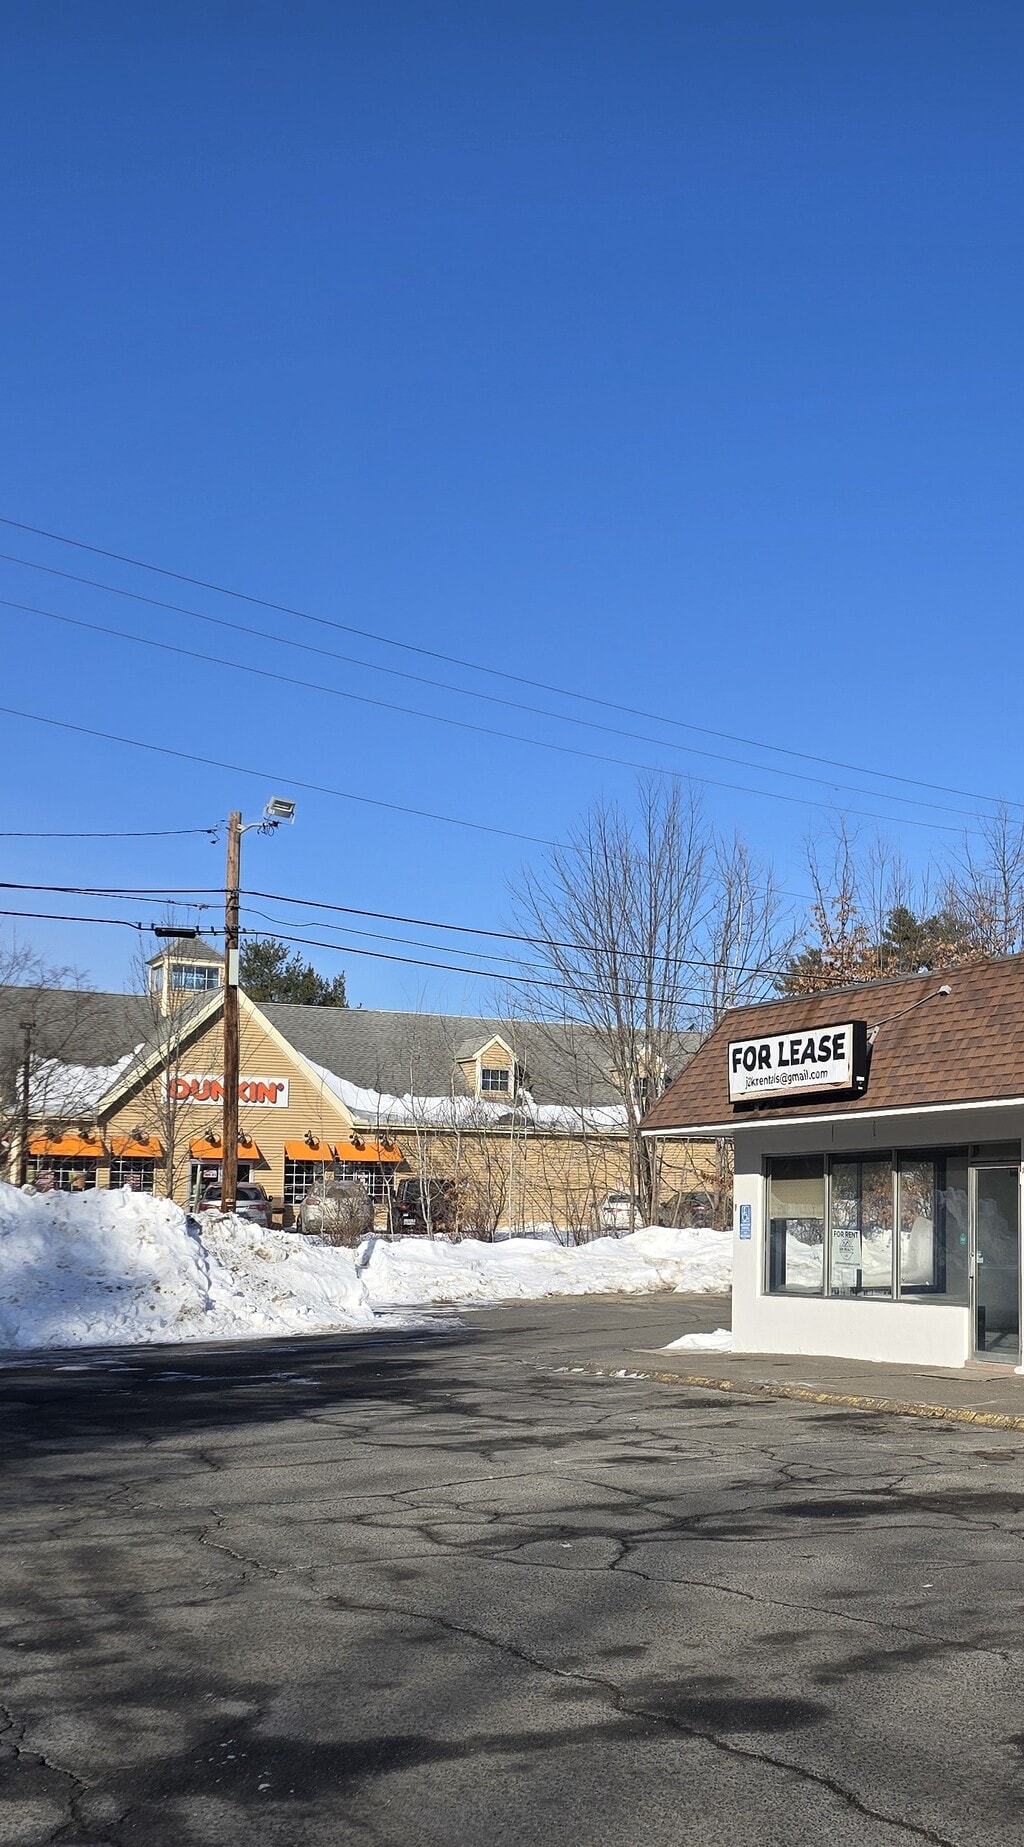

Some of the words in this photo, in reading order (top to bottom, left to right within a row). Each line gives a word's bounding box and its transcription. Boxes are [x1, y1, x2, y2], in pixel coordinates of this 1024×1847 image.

[732, 1044, 772, 1074] FOR
[778, 1032, 846, 1068] LEASE
[833, 1230, 845, 1238] FOR
[845, 1231, 858, 1239] RENT
